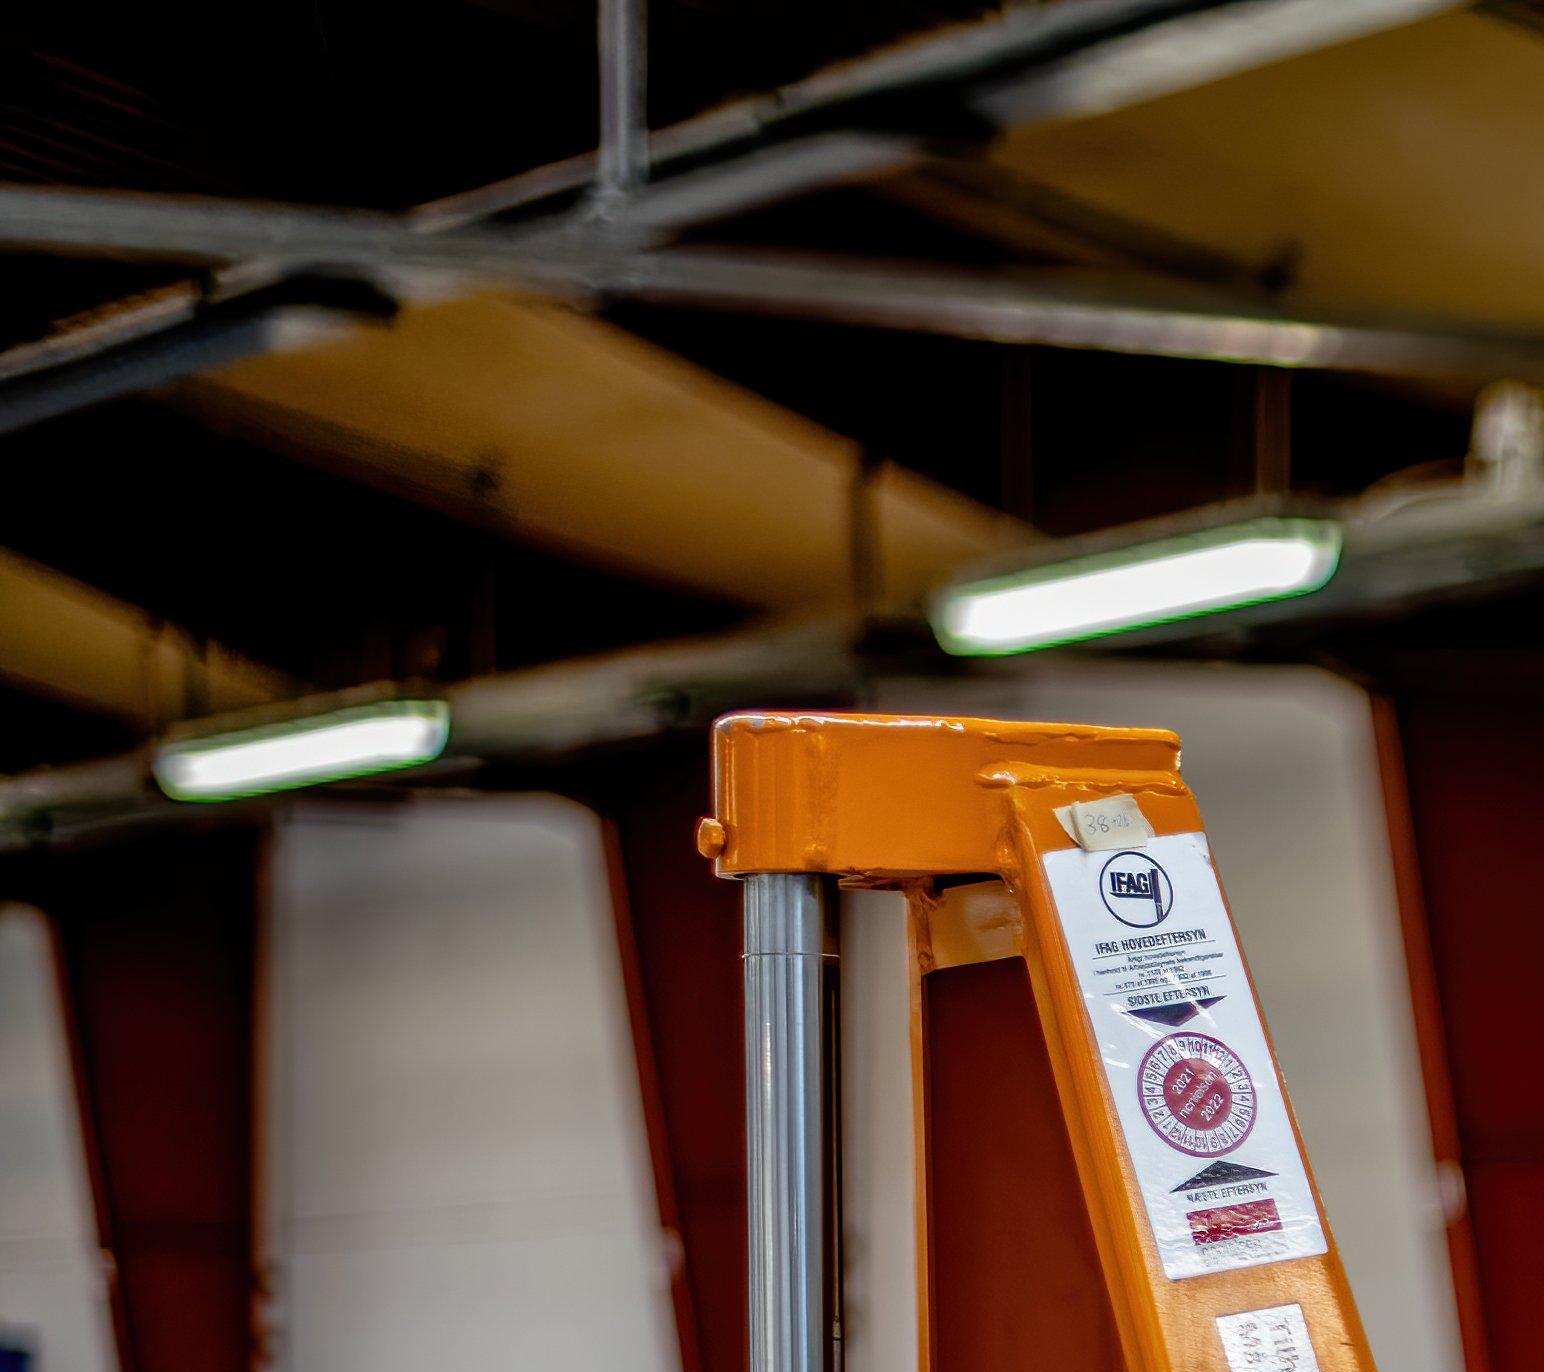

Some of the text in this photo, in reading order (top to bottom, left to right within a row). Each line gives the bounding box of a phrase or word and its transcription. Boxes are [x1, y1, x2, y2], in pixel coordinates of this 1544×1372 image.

[1085, 814, 1110, 835] 38
[1110, 872, 1150, 893] IFAG
[1095, 929, 1207, 954] IFAG HOVEDEFTERSYN
[1179, 1040, 1185, 1051] 9
[1188, 1040, 1201, 1053] 10
[1172, 1068, 1196, 1095] 2021
[1201, 1094, 1225, 1121] 2022
